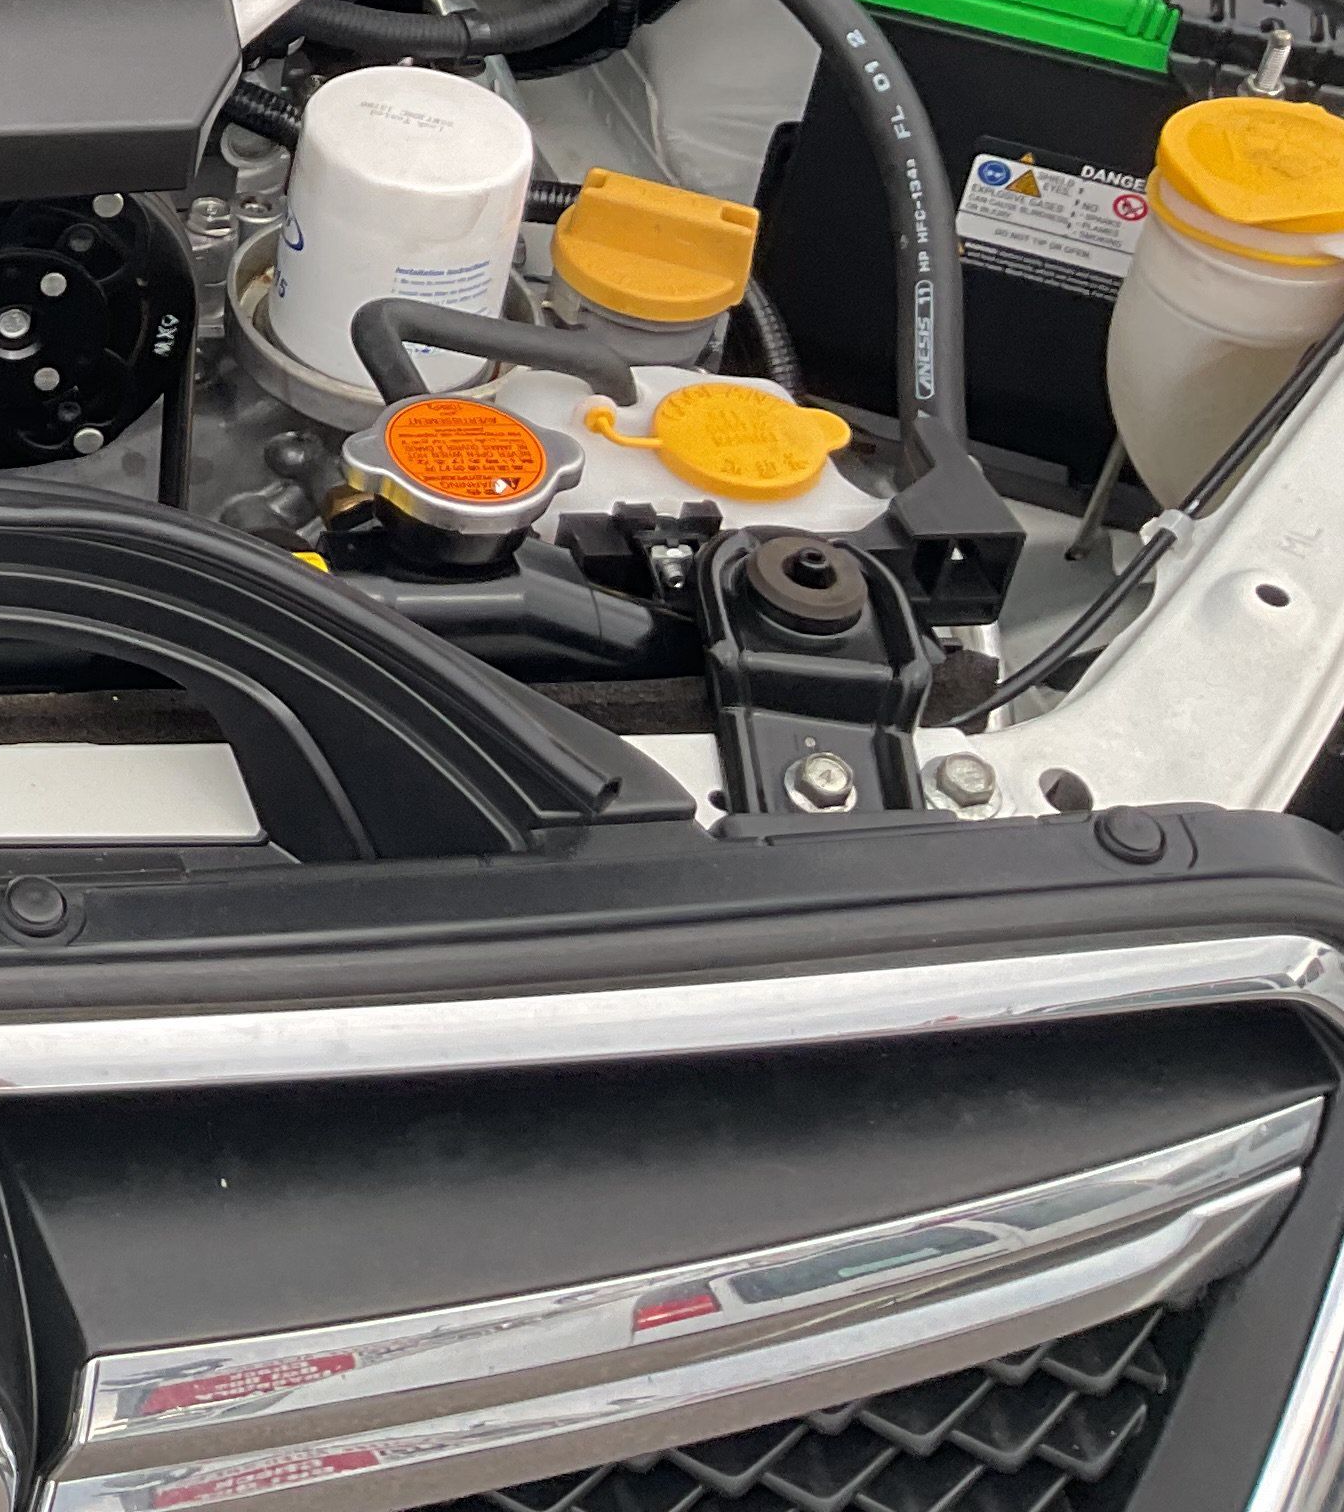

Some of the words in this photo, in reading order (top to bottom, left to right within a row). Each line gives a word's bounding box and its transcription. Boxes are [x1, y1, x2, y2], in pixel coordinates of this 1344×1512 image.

[864, 60, 891, 92] 01
[890, 104, 912, 140] FL
[1080, 165, 1147, 193] DANGE
[918, 251, 931, 272] HP
